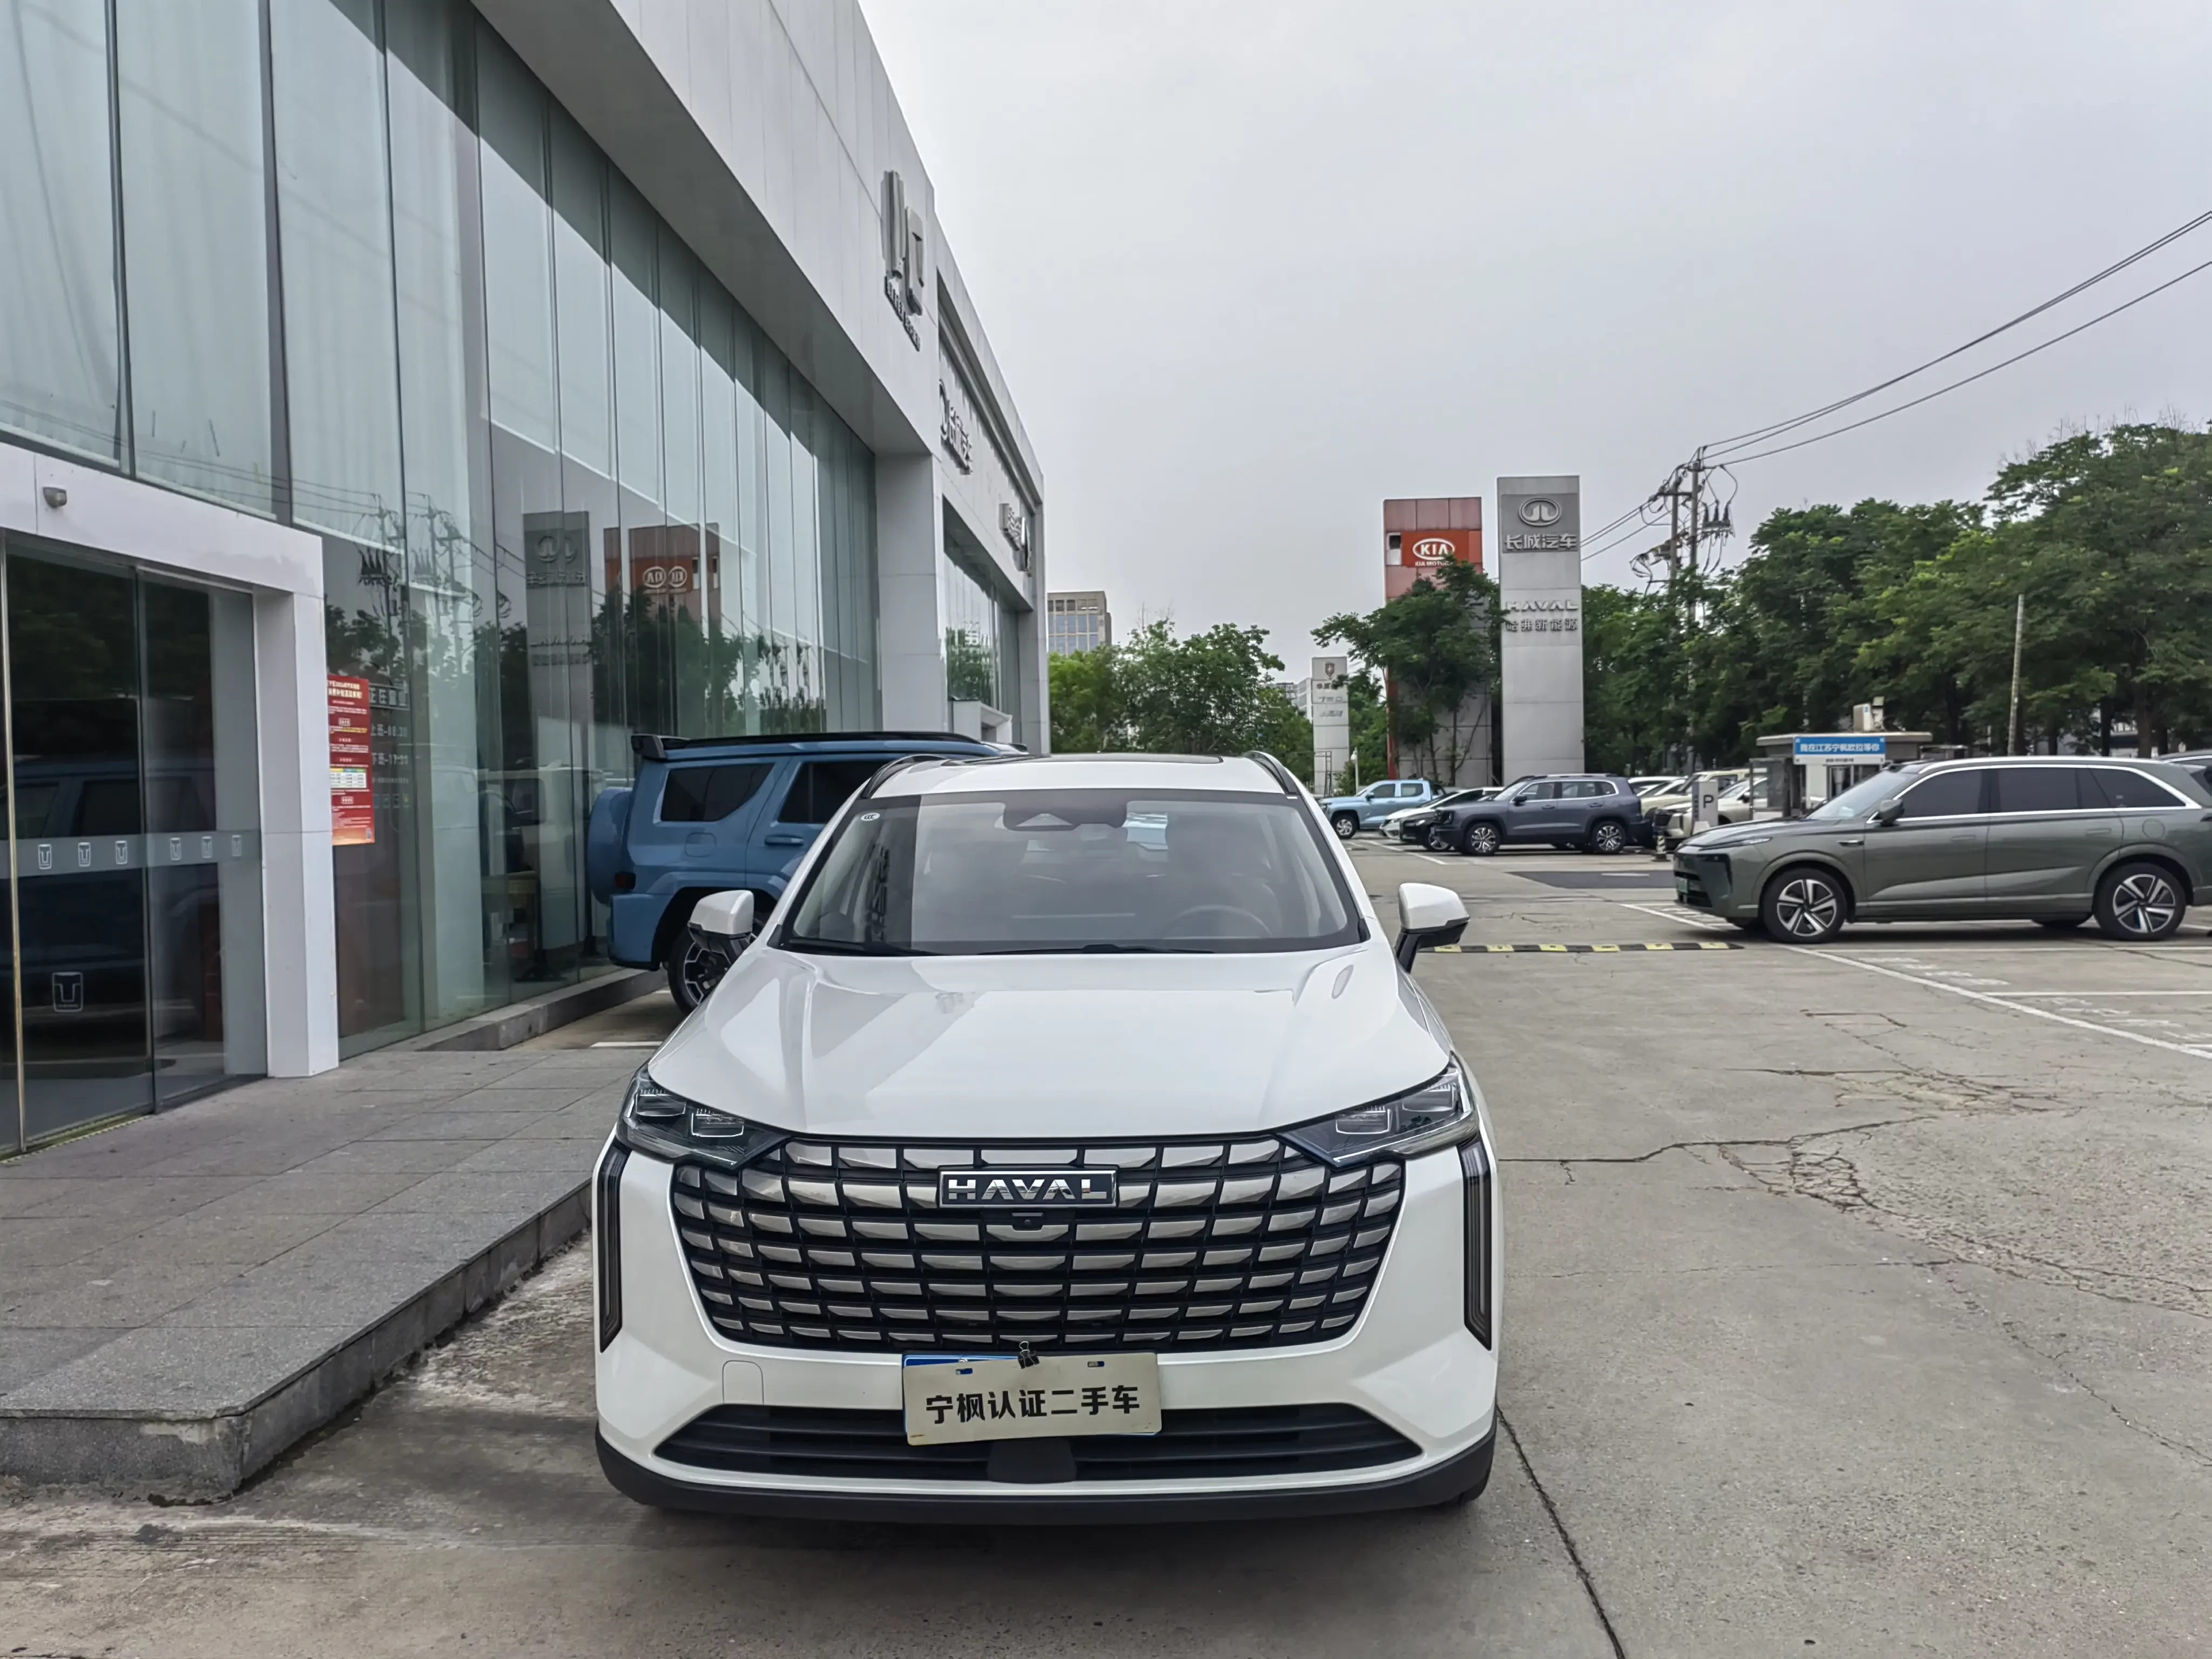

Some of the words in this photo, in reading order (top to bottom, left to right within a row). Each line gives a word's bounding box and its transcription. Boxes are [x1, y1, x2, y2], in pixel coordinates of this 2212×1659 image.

[1420, 544, 1448, 555] KIA
[1505, 534, 1577, 550] 长城汽车
[1506, 600, 1579, 612] HAVAL
[1703, 794, 1714, 808] P
[949, 1179, 1107, 1200] HAVAL
[926, 1385, 1139, 1425] 宁枫认证二手车
